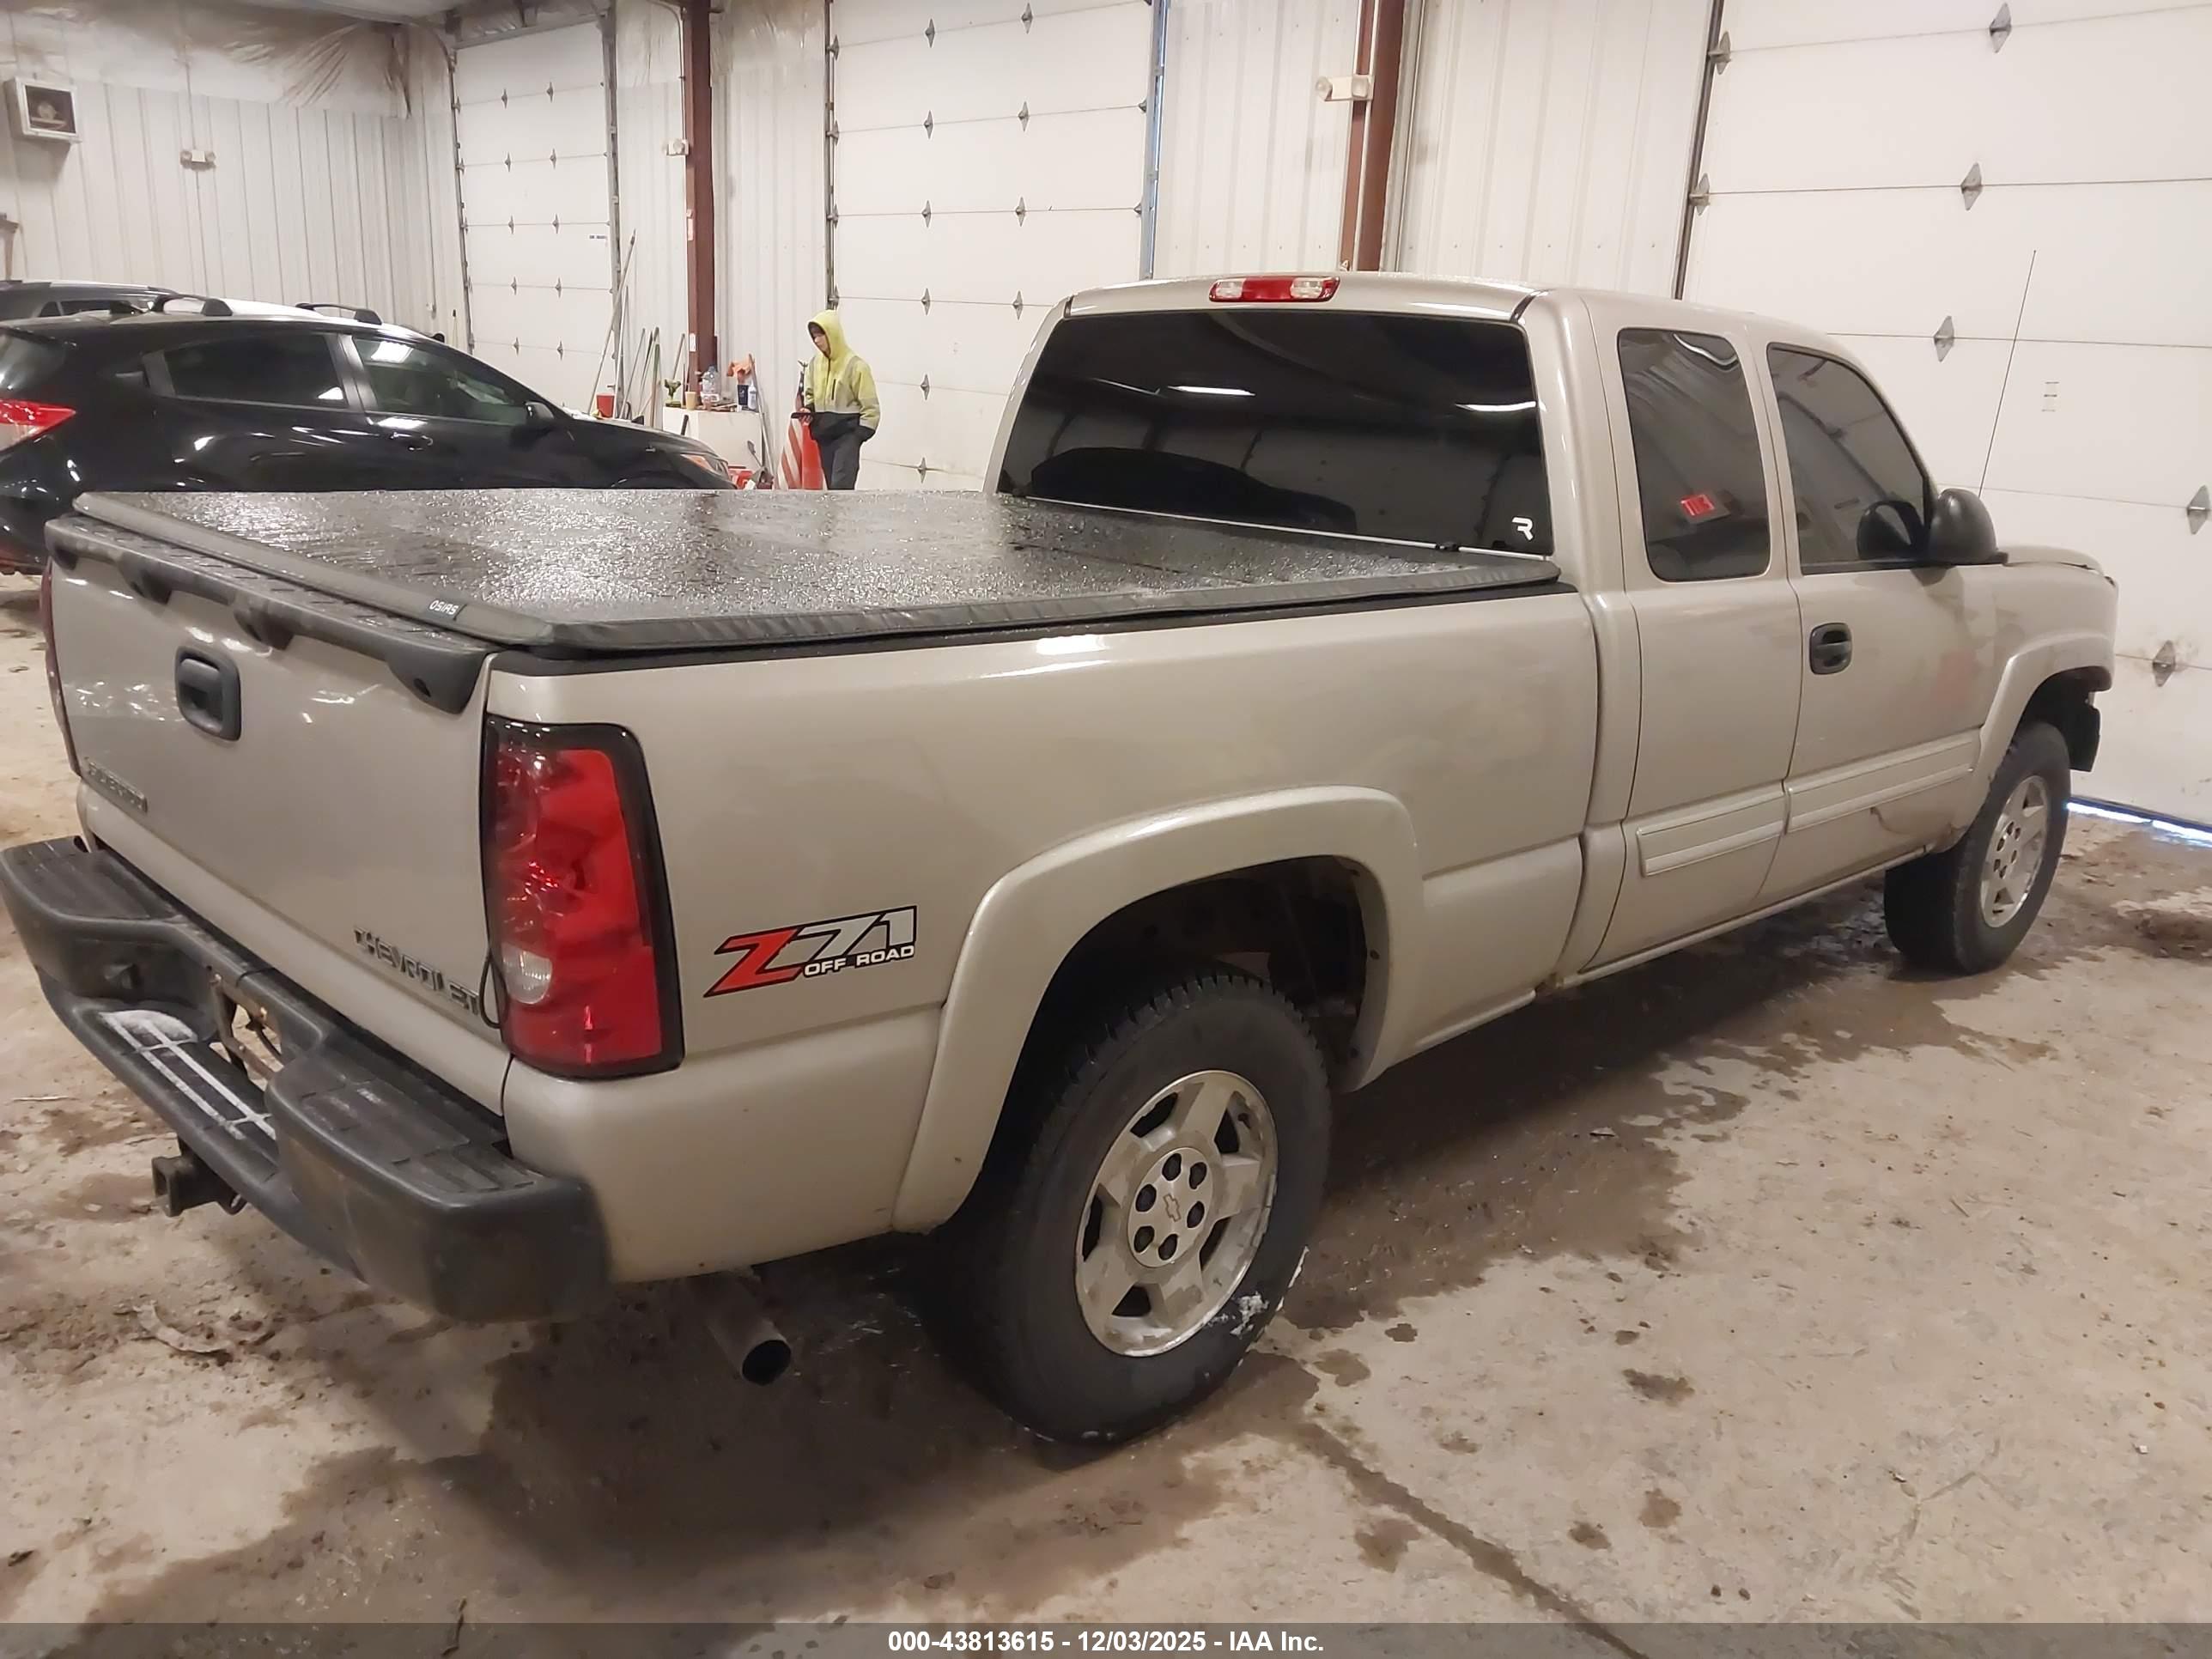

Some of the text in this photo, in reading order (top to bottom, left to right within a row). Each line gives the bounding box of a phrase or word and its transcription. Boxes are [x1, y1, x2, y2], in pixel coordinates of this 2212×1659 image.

[1511, 516, 1534, 541] R
[702, 905, 918, 998] Z71
[803, 944, 916, 977] OFF ROAD
